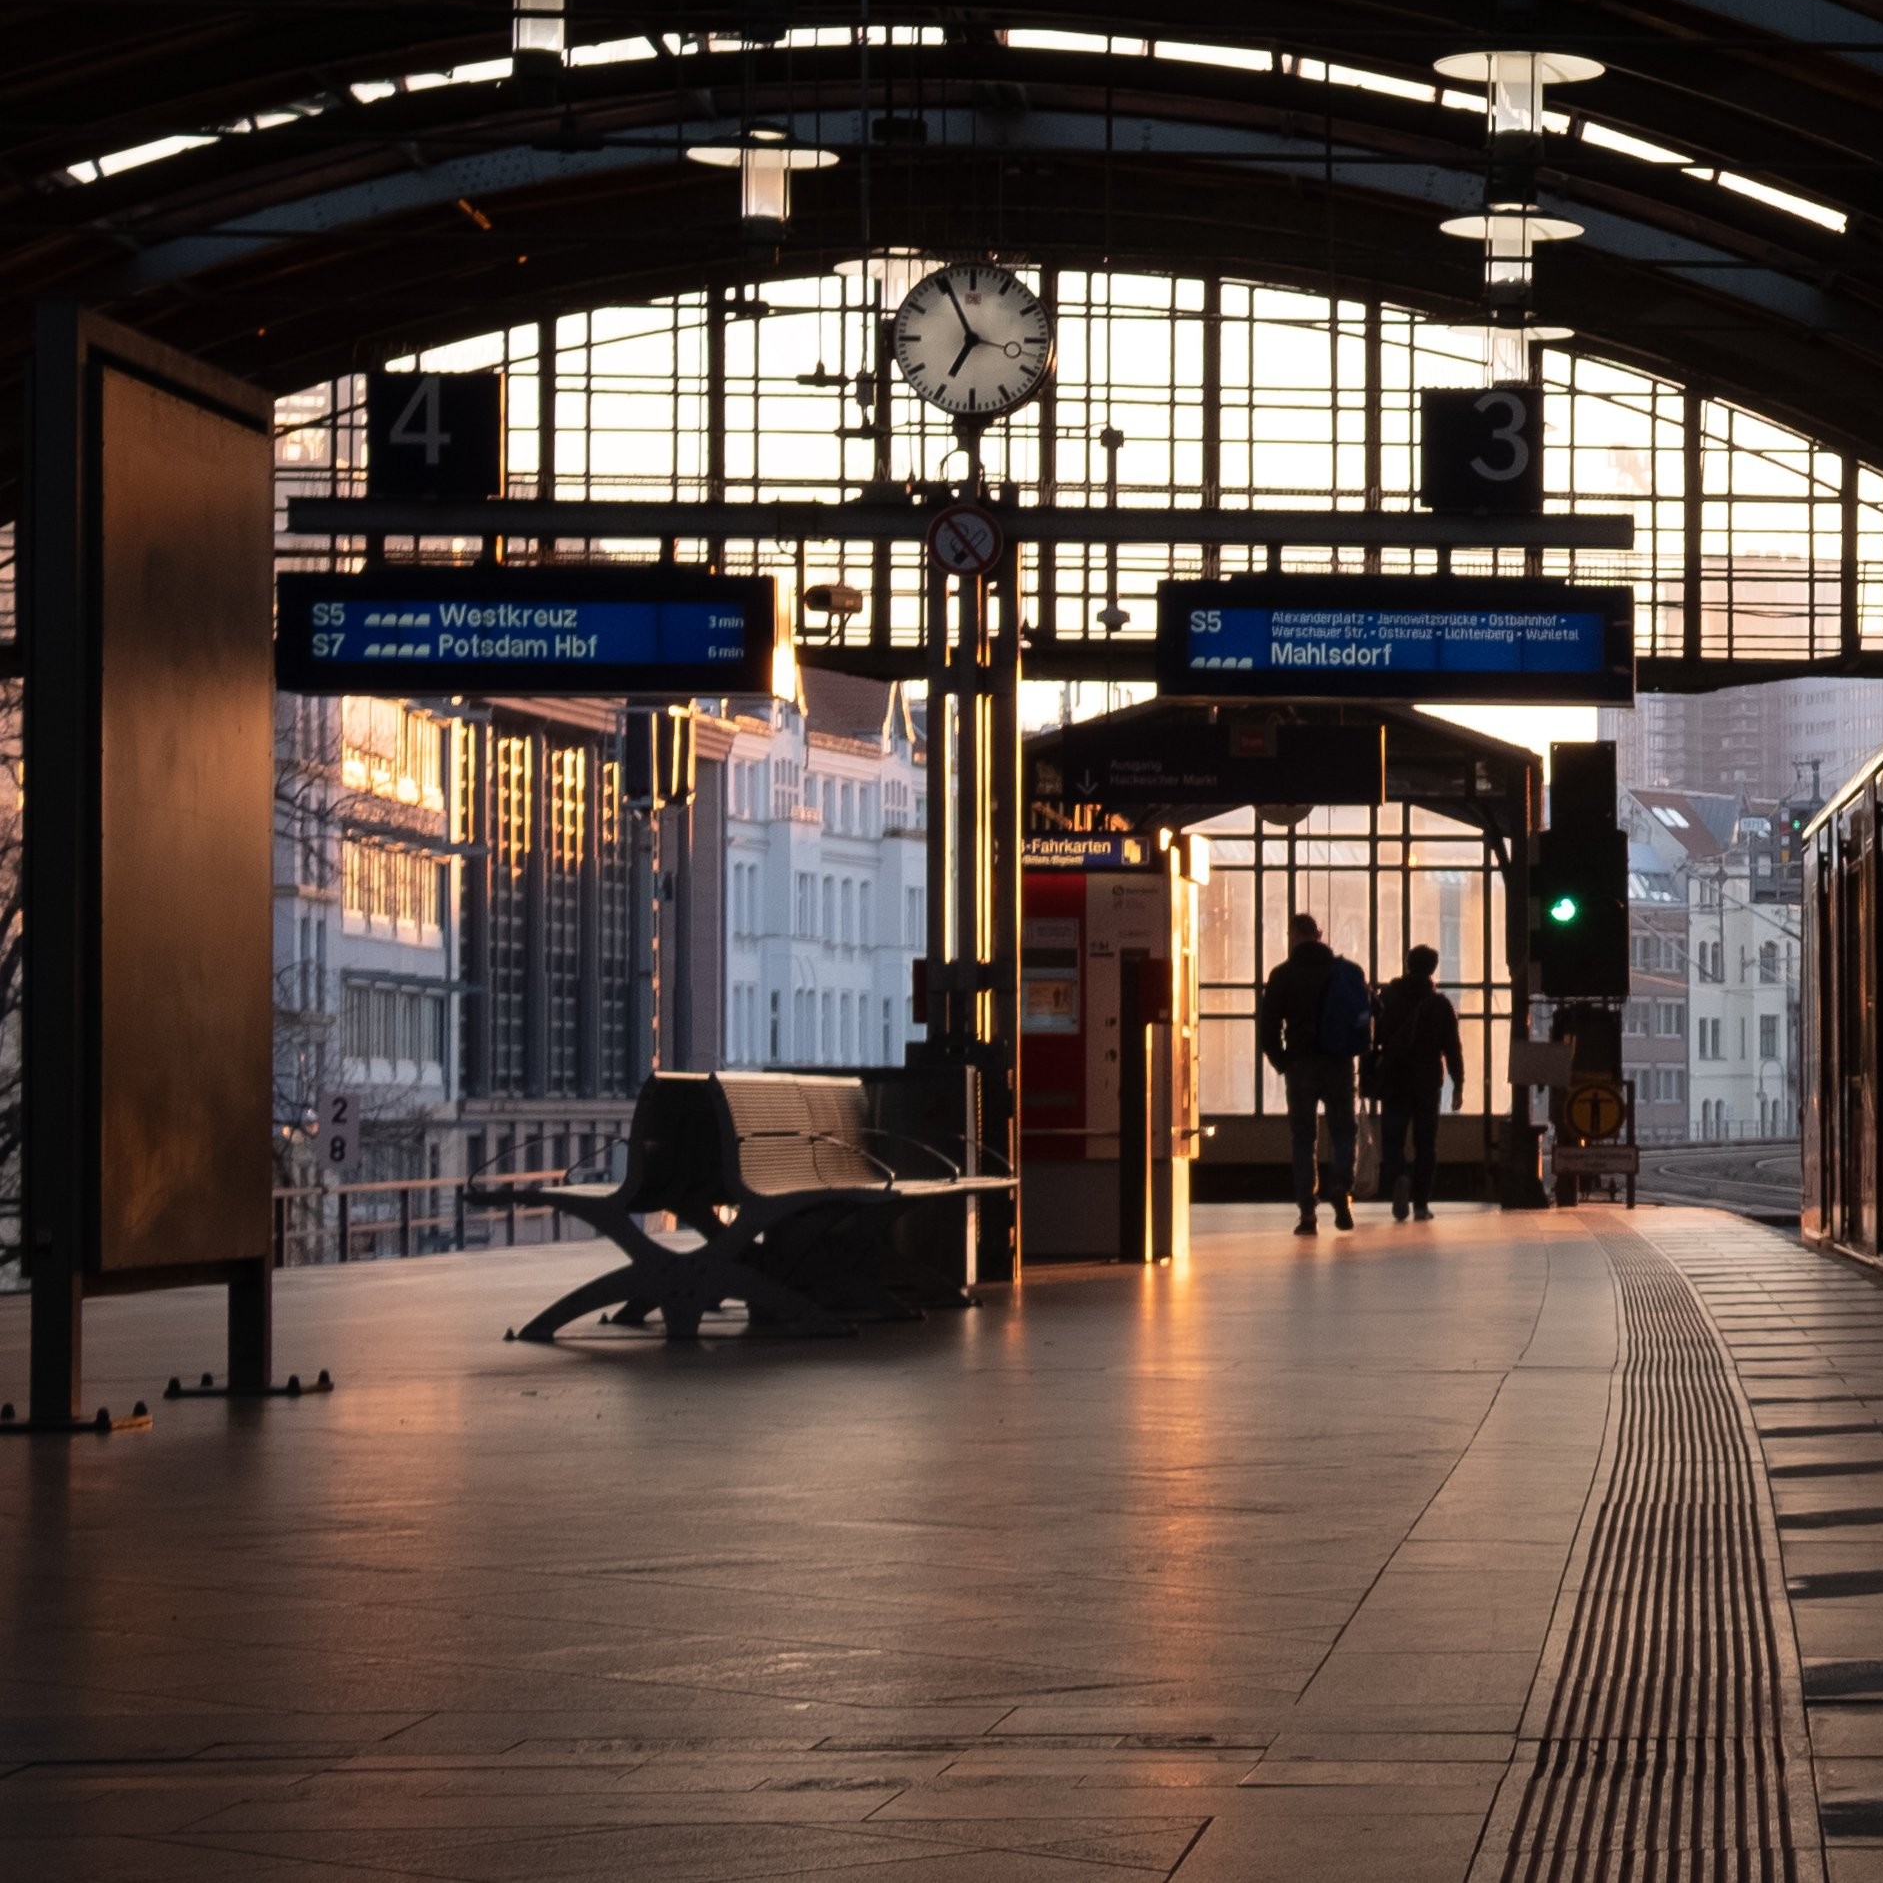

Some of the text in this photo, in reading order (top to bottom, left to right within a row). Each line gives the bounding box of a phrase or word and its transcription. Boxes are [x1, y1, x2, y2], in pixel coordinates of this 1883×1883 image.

[389, 374, 452, 466] 4
[1470, 391, 1529, 481] 3
[312, 603, 345, 627] S5
[440, 603, 578, 628] Westkreuz
[719, 615, 744, 628] min
[1190, 610, 1222, 633] S5
[1272, 612, 1365, 626] Alexanderplatz
[1489, 614, 1557, 627] Ostbahnhof
[312, 633, 345, 657] S7
[438, 633, 548, 658] Potsdam
[554, 633, 598, 659] Hbf
[719, 646, 744, 658] min
[1272, 625, 1580, 643] Warschauer Str. Ostkreuz Lichtenberg Wuhletal
[1271, 642, 1392, 666] Mahlsdorf
[332, 1097, 348, 1124] 2
[330, 1136, 346, 1162] 8
